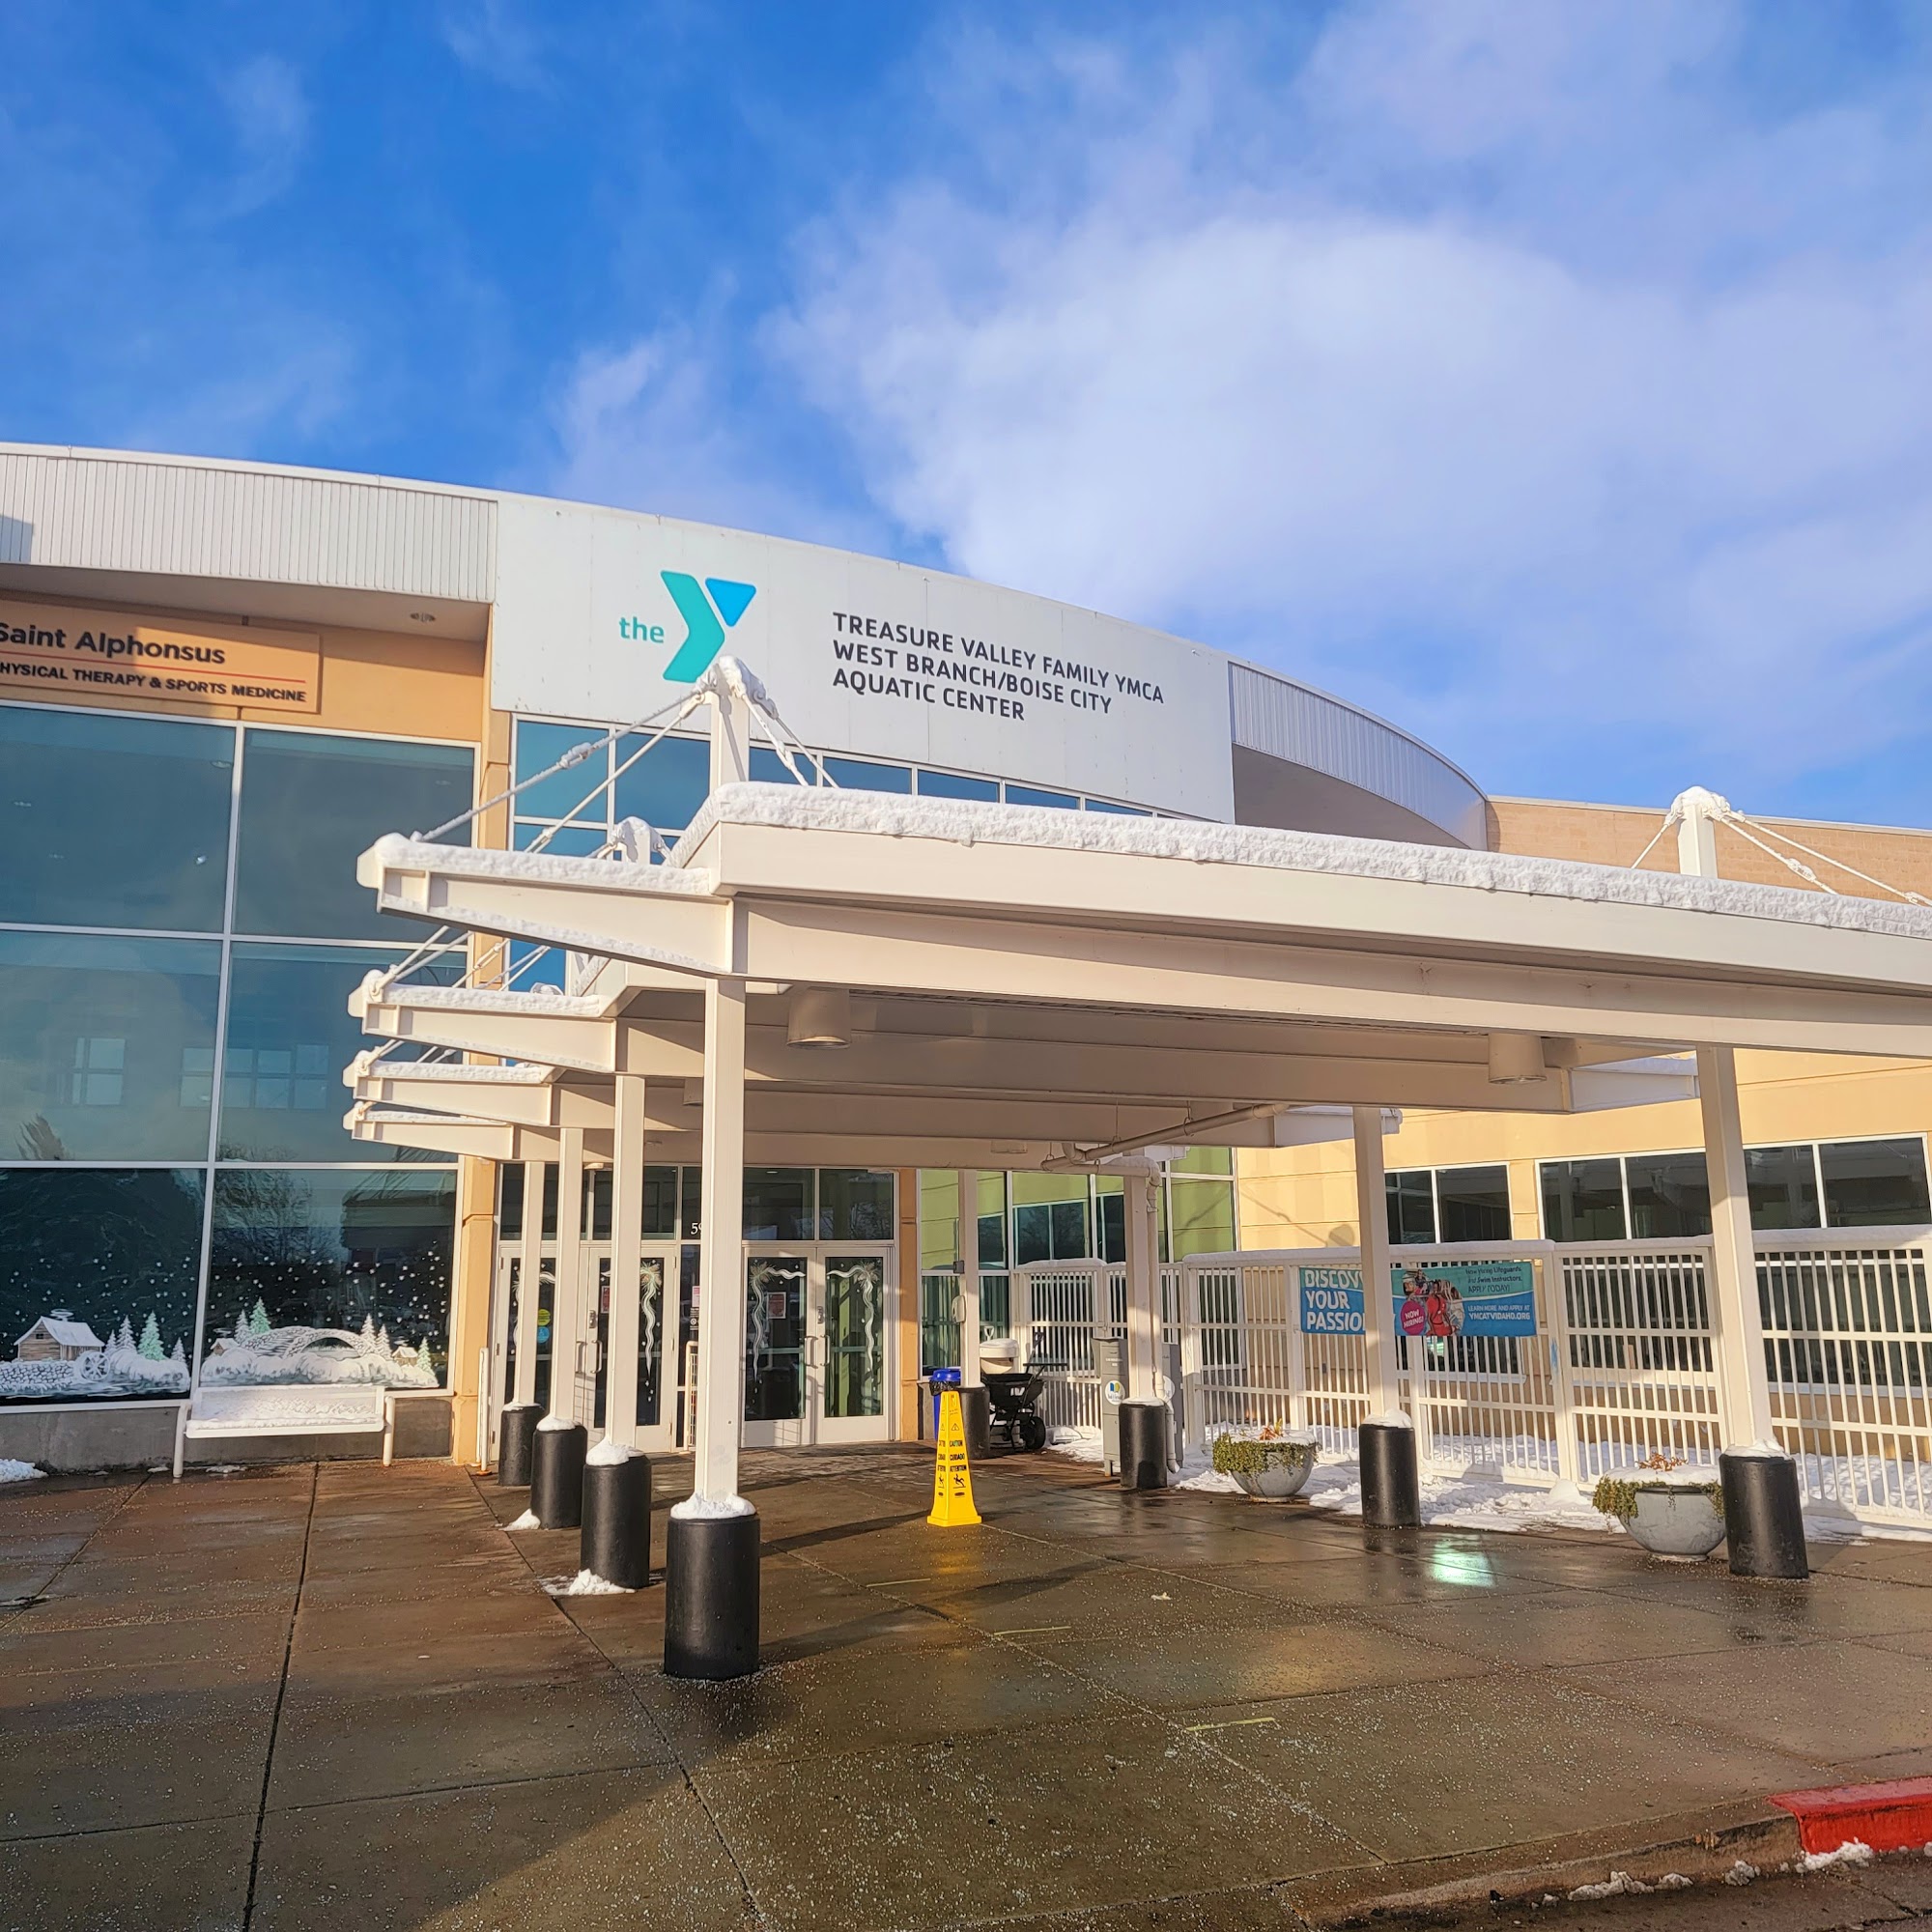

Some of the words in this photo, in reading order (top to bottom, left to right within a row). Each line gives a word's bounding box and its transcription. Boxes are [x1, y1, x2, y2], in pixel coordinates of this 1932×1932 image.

[618, 616, 665, 643] the
[74, 630, 226, 665] Alphonsus
[833, 611, 953, 653] TREASURE
[961, 637, 1037, 670] VALLEY
[1042, 656, 1110, 689] FAMILY
[1115, 673, 1164, 704] YMCA
[72, 668, 147, 687] THERAPY
[150, 677, 162, 689] &
[165, 678, 227, 695] SPORTS
[231, 684, 307, 702] MEDICINE
[833, 639, 898, 668] WEST
[906, 653, 1064, 703] BRANCH/BOISE
[1069, 689, 1112, 714] CITY
[833, 668, 936, 704] AQUATIC
[943, 688, 1025, 721] CENTER
[1304, 1269, 1363, 1289] DISCOV
[1468, 1285, 1486, 1293] APPLY
[1305, 1290, 1350, 1310] YOUR
[1306, 1311, 1365, 1332] PASSIO
[1405, 1309, 1420, 1321] NOW
